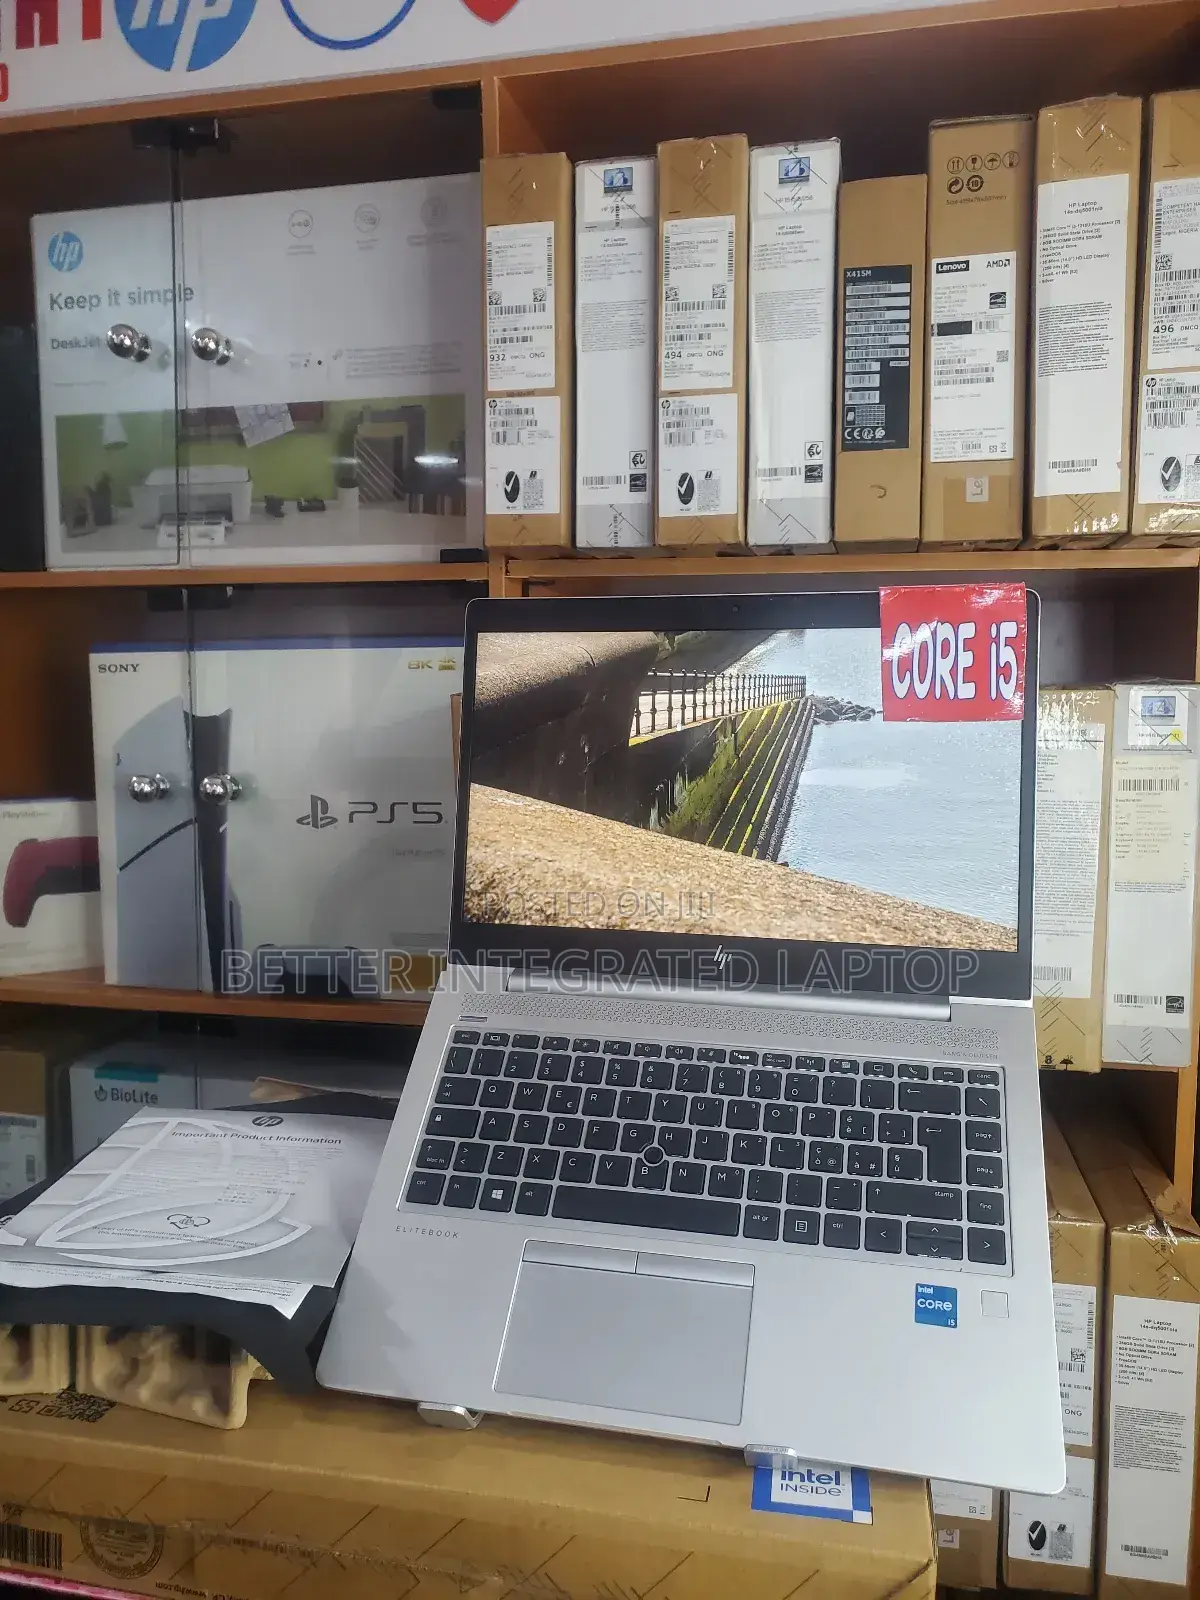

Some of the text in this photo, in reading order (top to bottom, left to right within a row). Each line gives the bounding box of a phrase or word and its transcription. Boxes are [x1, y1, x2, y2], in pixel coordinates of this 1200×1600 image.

[986, 259, 1003, 269] AMD
[49, 284, 195, 312] Keep it simple
[1153, 324, 1174, 334] 496
[489, 351, 545, 362] 932 ONG
[664, 350, 724, 360] 494 ONG
[891, 621, 1019, 701] CORE i5
[97, 663, 140, 674] SONY
[348, 802, 444, 824] PS5
[543, 1067, 550, 1075] 3
[682, 1078, 689, 1086] 7
[755, 1085, 761, 1093] 9
[111, 1087, 160, 1105] BioLite
[488, 1085, 497, 1093] Q
[523, 1087, 534, 1095] W
[556, 1090, 562, 1098] E
[590, 1093, 598, 1101] R
[625, 1096, 632, 1104] T
[662, 1099, 670, 1107] Y
[772, 1109, 780, 1118] O
[808, 1112, 816, 1121] P
[171, 1131, 342, 1144] Important Product Information
[489, 1118, 496, 1126] A
[557, 1123, 565, 1131] D
[592, 1126, 599, 1134] F
[665, 1133, 673, 1141] H
[739, 1140, 748, 1148] K
[778, 1144, 783, 1152] L
[497, 1152, 505, 1160] Z
[532, 1155, 540, 1163] X
[569, 1158, 576, 1166] C
[605, 1161, 613, 1169] V
[642, 1167, 649, 1175] B
[679, 1169, 687, 1177] N
[717, 1173, 726, 1181] M
[934, 1191, 954, 1199] stamp
[396, 1225, 458, 1238] ELITEBOOK
[918, 1286, 933, 1294] intel
[917, 1298, 953, 1311] CORE
[1064, 1408, 1082, 1417] ONG
[781, 1468, 841, 1486] intel
[780, 1483, 842, 1497] INSIDE
